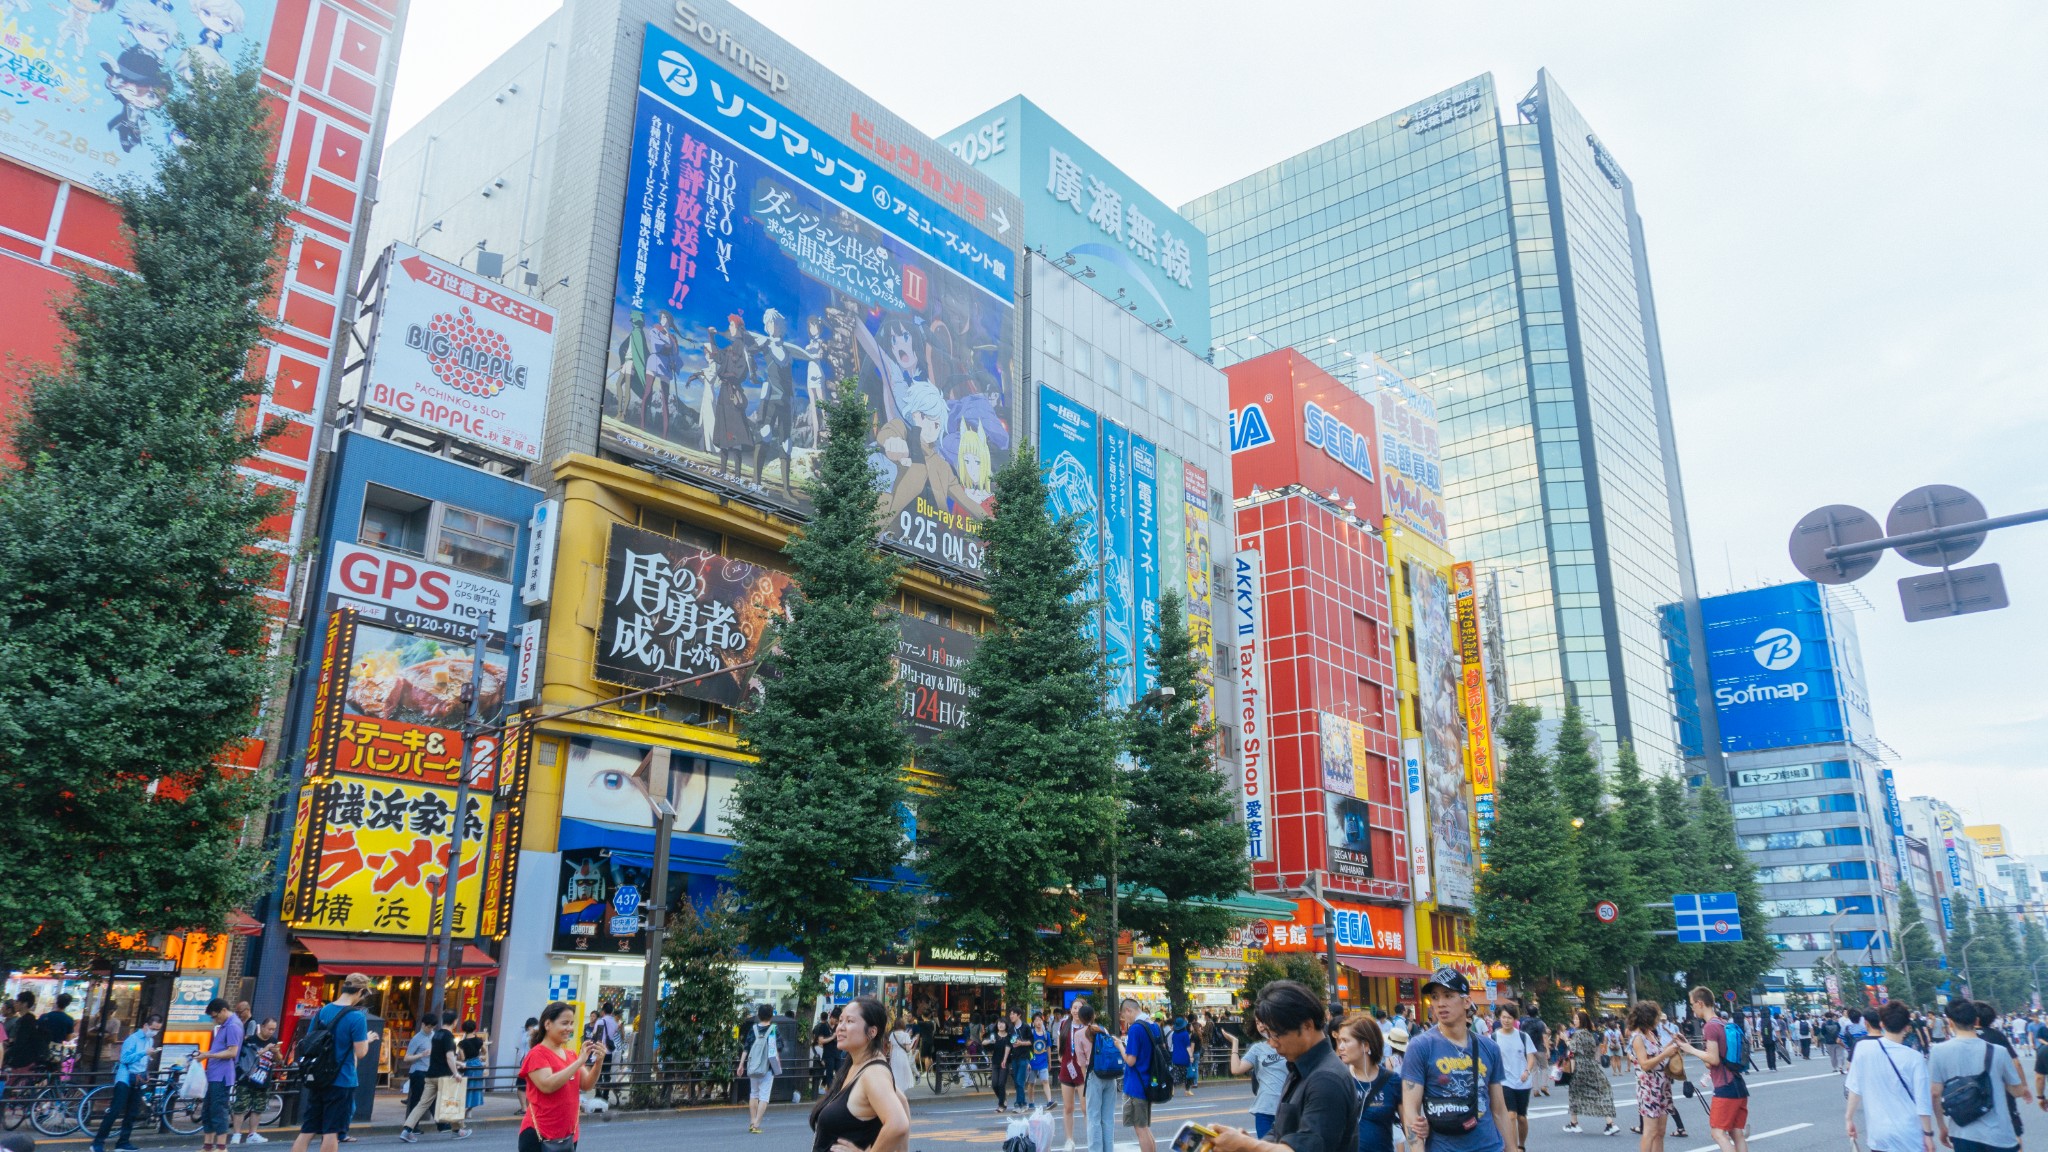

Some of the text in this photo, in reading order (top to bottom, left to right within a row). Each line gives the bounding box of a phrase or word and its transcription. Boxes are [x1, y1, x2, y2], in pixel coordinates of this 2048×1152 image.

[672, 0, 789, 93] Sofmap
[1415, 85, 1479, 120] 住友不動産
[710, 79, 867, 194] ソフマップ
[850, 112, 986, 222] ビックカメラ
[719, 157, 738, 236] TOKYO
[668, 132, 708, 310] 好評放送中!!
[1046, 144, 1193, 290] 廣瀬無線
[405, 323, 528, 390] BIG APPLE
[373, 383, 415, 412] BIG
[414, 382, 471, 410] PACHINKO
[480, 405, 506, 421] SLOT
[488, 429, 536, 456] 秋葉原店
[1304, 400, 1375, 484] SEGA
[1383, 433, 1443, 496] 高額買取
[917, 496, 955, 530] Blu-ray
[957, 514, 964, 529] &
[899, 510, 938, 554] 9.25
[942, 532, 963, 564] ON
[339, 551, 451, 612] GPS
[454, 589, 497, 607] GPS 専門店
[456, 579, 501, 599] リアルタイム
[616, 548, 697, 616] 盾の
[1235, 557, 1254, 622] AKKY
[406, 613, 494, 643] 0120-915-07
[452, 602, 497, 624] next
[659, 589, 747, 651] 勇者の
[520, 636, 534, 684] GPS
[609, 612, 720, 675] 成り上がり
[900, 662, 937, 691] Blu-ray
[937, 676, 945, 691] &
[945, 675, 965, 696] DVD
[1240, 639, 1258, 735] Tax-free
[1715, 681, 1809, 706] Sofmap
[338, 718, 446, 755] ステーキ&
[304, 761, 318, 778] 2F
[1244, 738, 1260, 797] Shop
[1407, 758, 1420, 794] SEGA
[500, 785, 512, 797] 1F
[327, 780, 484, 842] 横浜家系
[288, 798, 309, 889] ラーメン
[317, 828, 481, 898] ラーメン
[486, 813, 506, 910] ステーキ&ハンバーグ
[1334, 849, 1348, 862] SEGA
[1339, 863, 1365, 876] AKIHABARA
[616, 893, 637, 906] 437
[1600, 907, 1613, 918] 50
[1264, 924, 1308, 947] 号館
[1377, 929, 1402, 952] 3号館
[918, 973, 931, 983] Best
[932, 974, 951, 983] Global
[1427, 1101, 1470, 1117] Supreme
